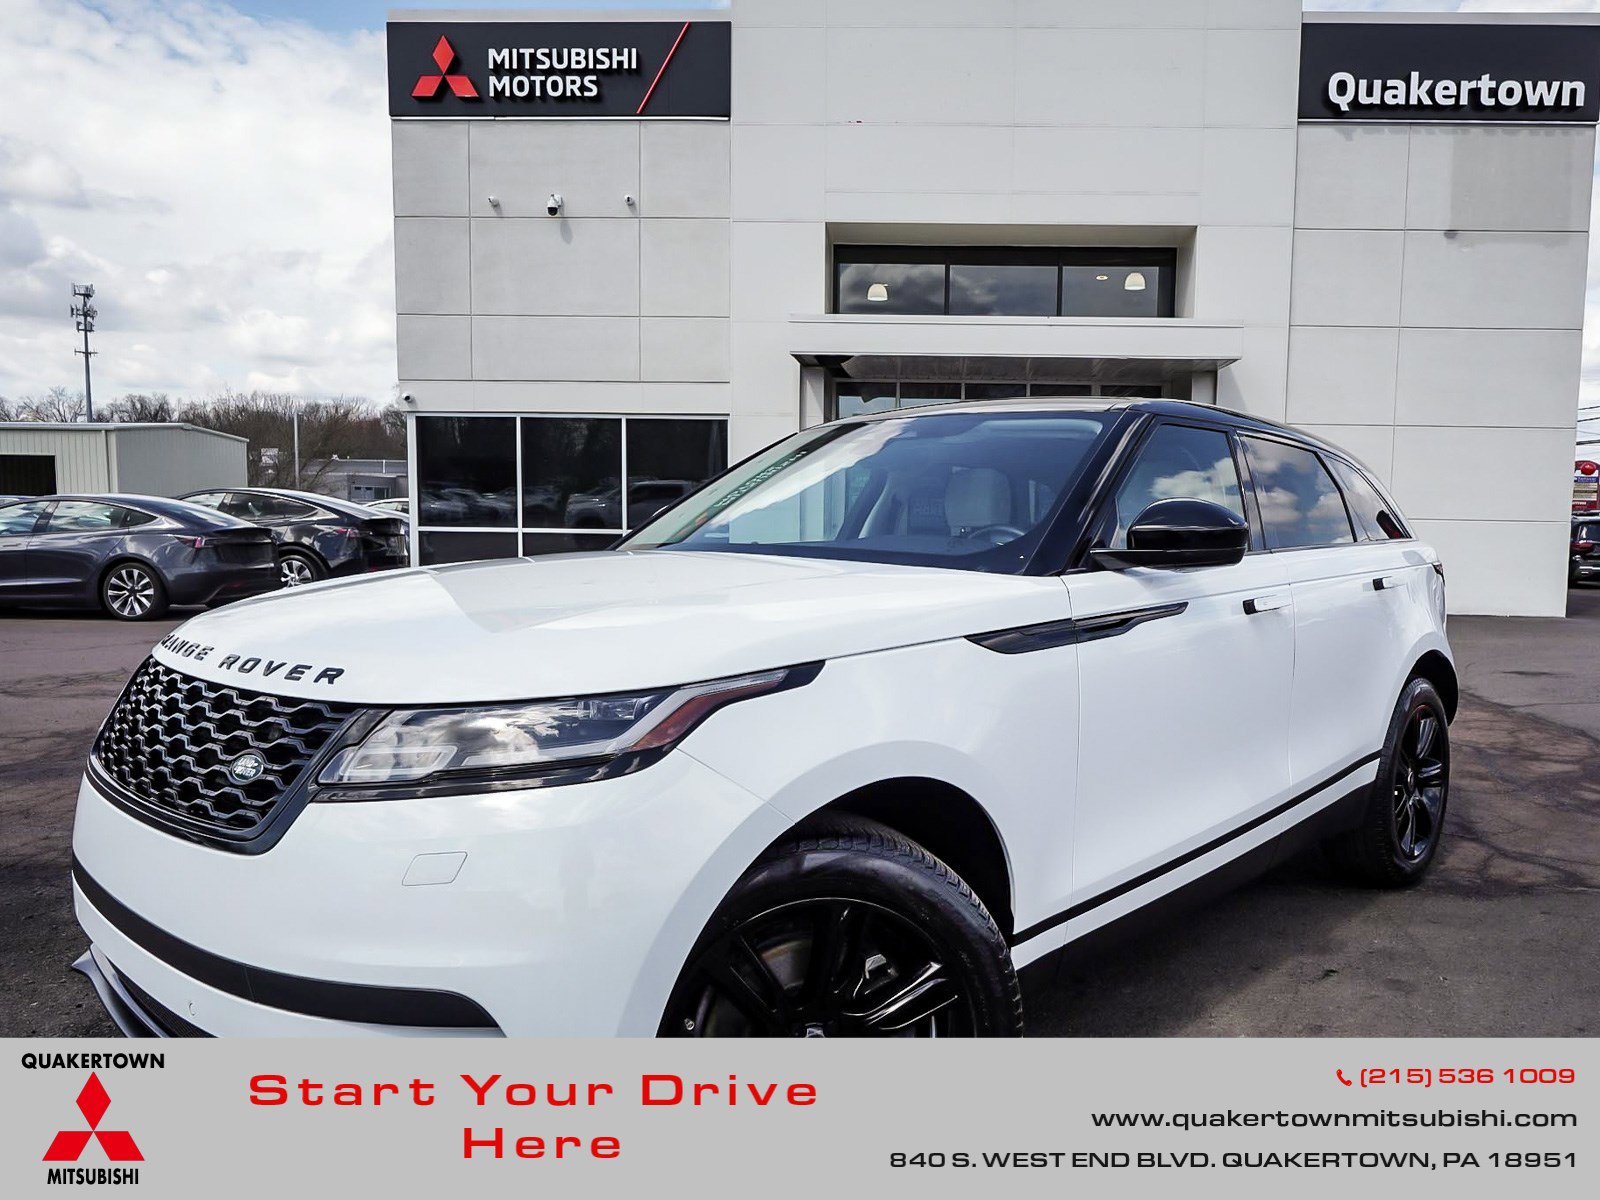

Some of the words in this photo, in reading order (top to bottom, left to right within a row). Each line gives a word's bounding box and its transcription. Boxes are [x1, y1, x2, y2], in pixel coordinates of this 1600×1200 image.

[488, 47, 637, 70] MITSUBISHI
[488, 75, 598, 97] MOTORS
[1328, 71, 1586, 112] Quakertown
[217, 653, 346, 685] ROVER
